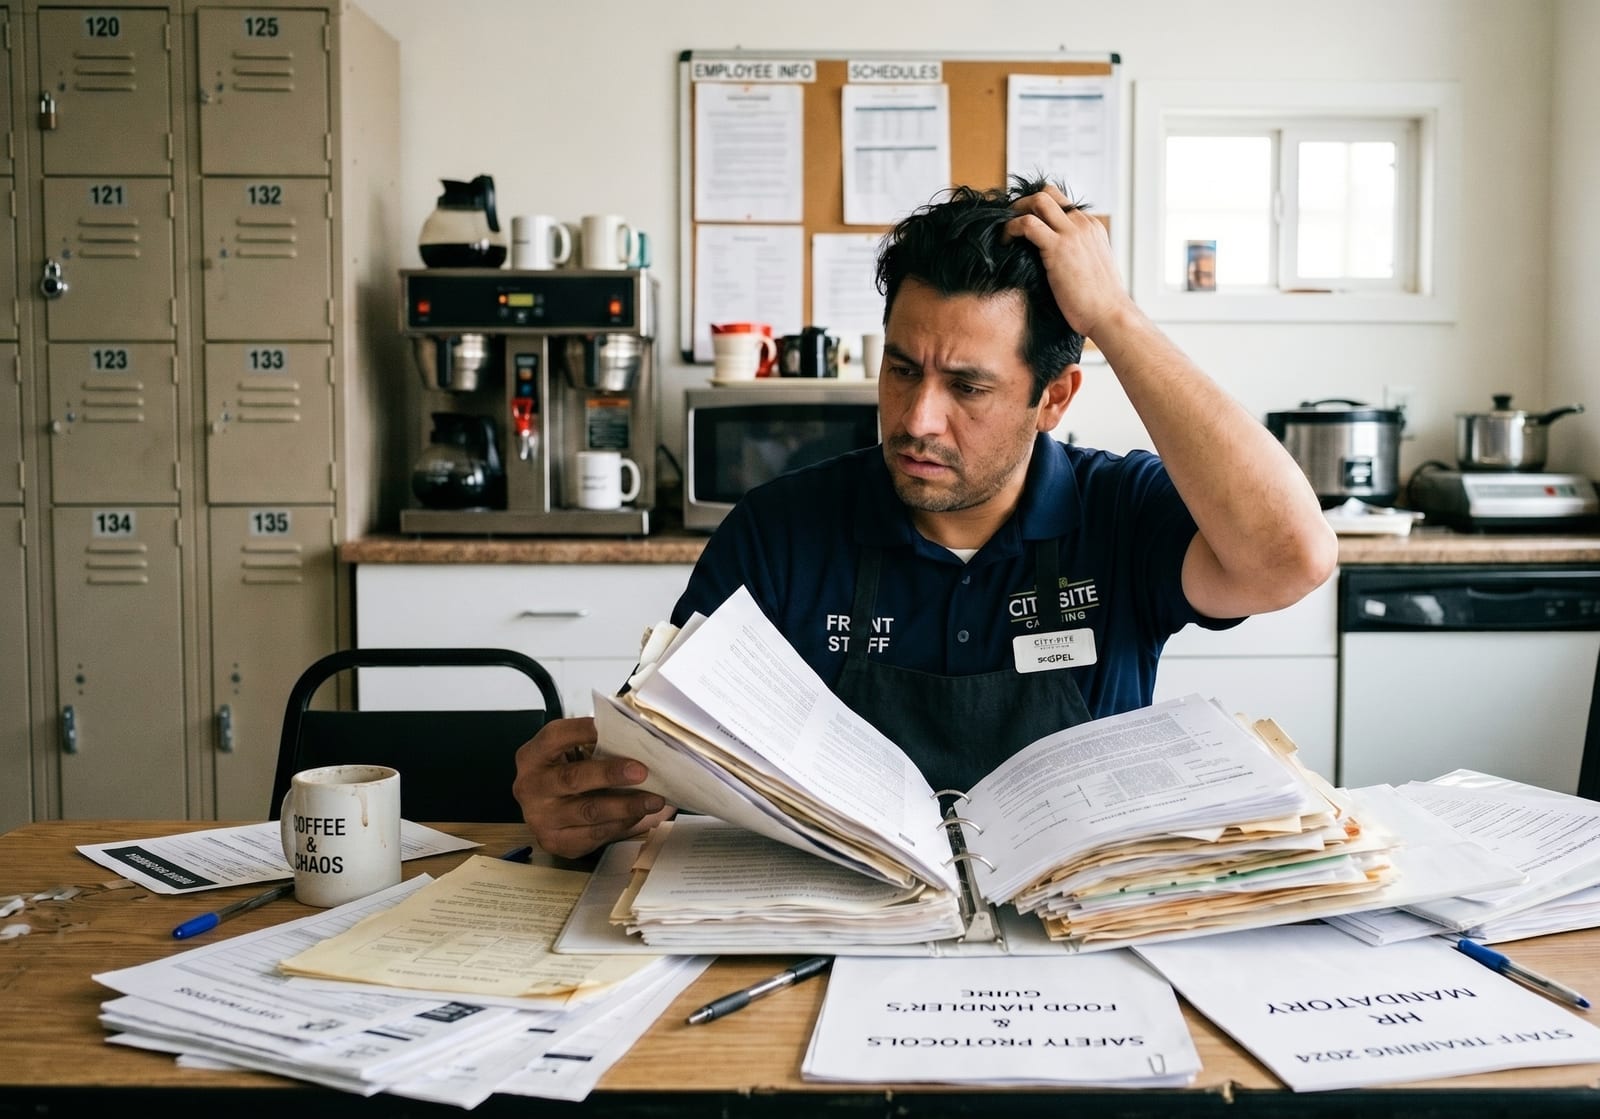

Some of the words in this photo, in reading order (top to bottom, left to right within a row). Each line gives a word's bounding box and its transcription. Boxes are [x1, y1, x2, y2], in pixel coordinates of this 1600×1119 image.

[86, 17, 120, 37] 120
[245, 17, 279, 37] 125
[695, 63, 773, 78] EMPLOYEE
[778, 64, 812, 78] INFO
[851, 64, 939, 79] SCHEDULES
[91, 185, 123, 205] 121
[248, 185, 282, 205] 132
[93, 350, 128, 370] 123
[250, 350, 284, 370] 133
[97, 513, 131, 533] 134
[254, 513, 289, 533] 135
[1009, 596, 1038, 617] CIT
[827, 614, 895, 633] FRNT
[828, 635, 890, 653] STFF
[293, 814, 346, 836] COFFEE
[306, 836, 318, 853] &
[295, 852, 344, 874] CHAOS
[886, 1002, 1034, 1013] HANDLER'S
[1043, 1003, 1117, 1012] FOOD
[1266, 988, 1477, 1014] MANDATORY
[992, 1018, 1011, 1028] &
[1368, 1011, 1424, 1025] HR
[867, 1037, 1033, 1047] PROTOCOLS
[1043, 1036, 1144, 1047] SAFETY
[1498, 1029, 1573, 1043] STAFF
[1295, 1050, 1360, 1063] 2024
[1364, 1037, 1493, 1057] TRAINING
